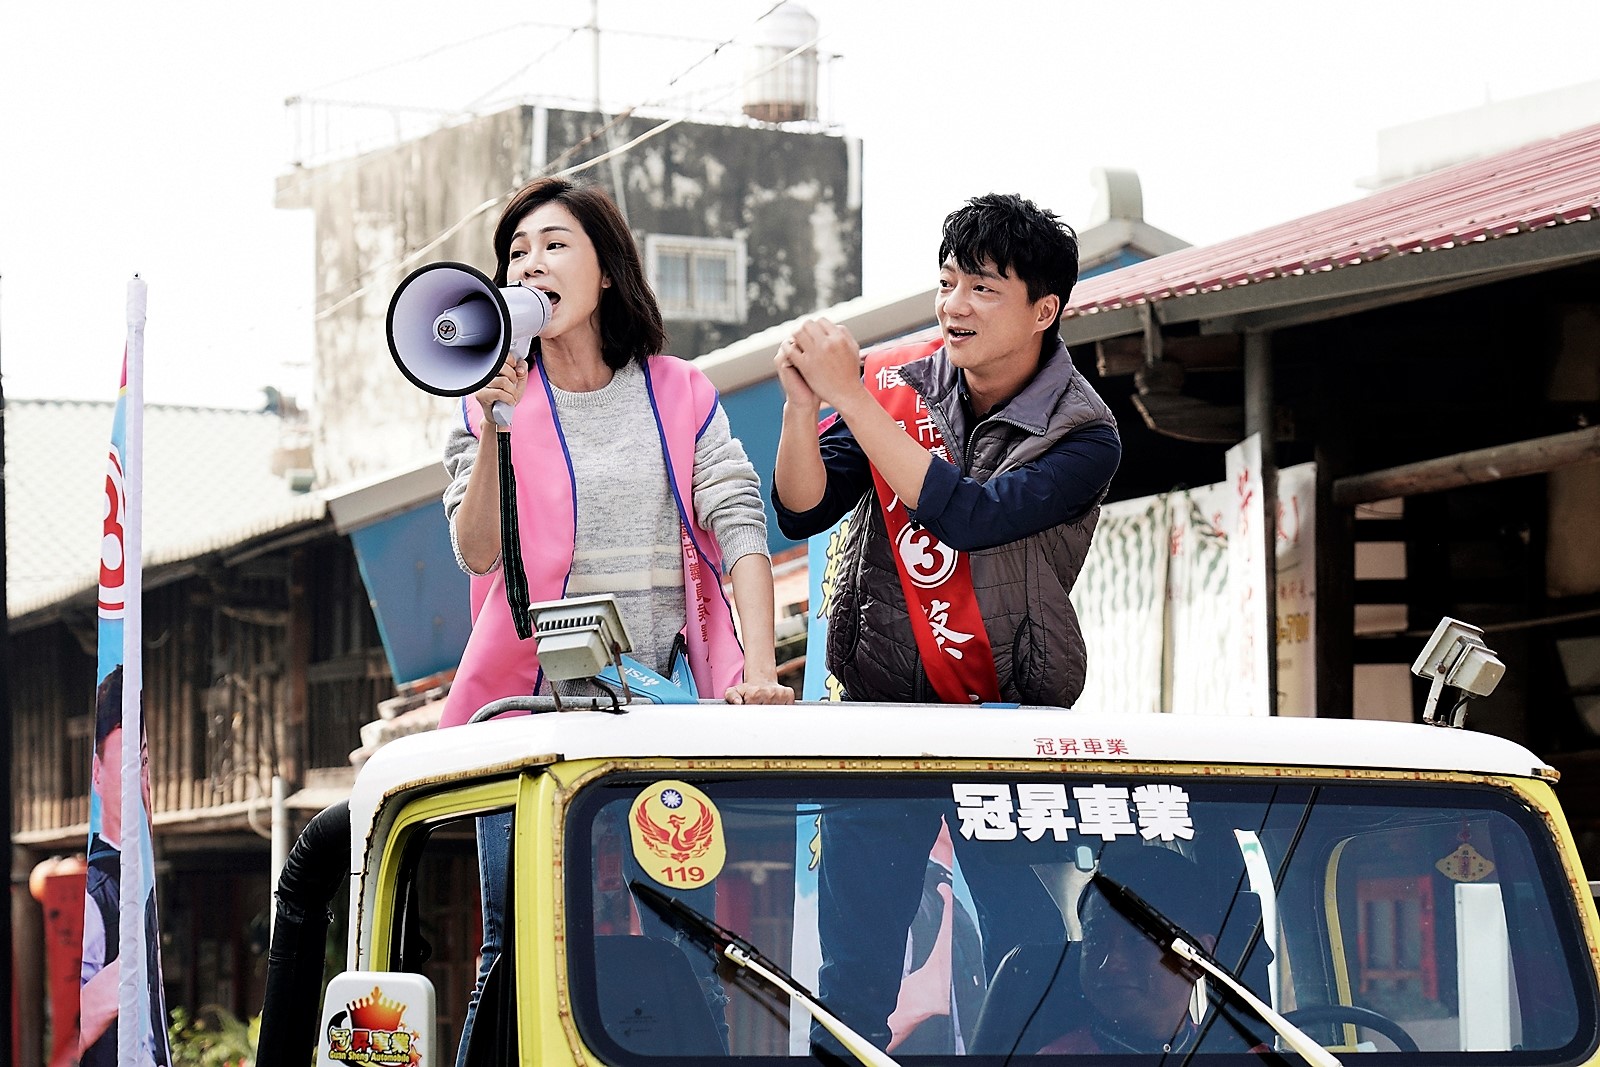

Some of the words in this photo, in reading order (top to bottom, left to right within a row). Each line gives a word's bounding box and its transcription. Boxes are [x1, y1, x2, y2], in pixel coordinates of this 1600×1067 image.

[909, 528, 945, 577] 3
[1034, 738, 1130, 756] 冠昇車業
[952, 783, 1195, 842] 冠昇車業
[661, 866, 705, 882] 119
[348, 1051, 369, 1062] Sheng
[371, 1053, 410, 1063] Automobile
